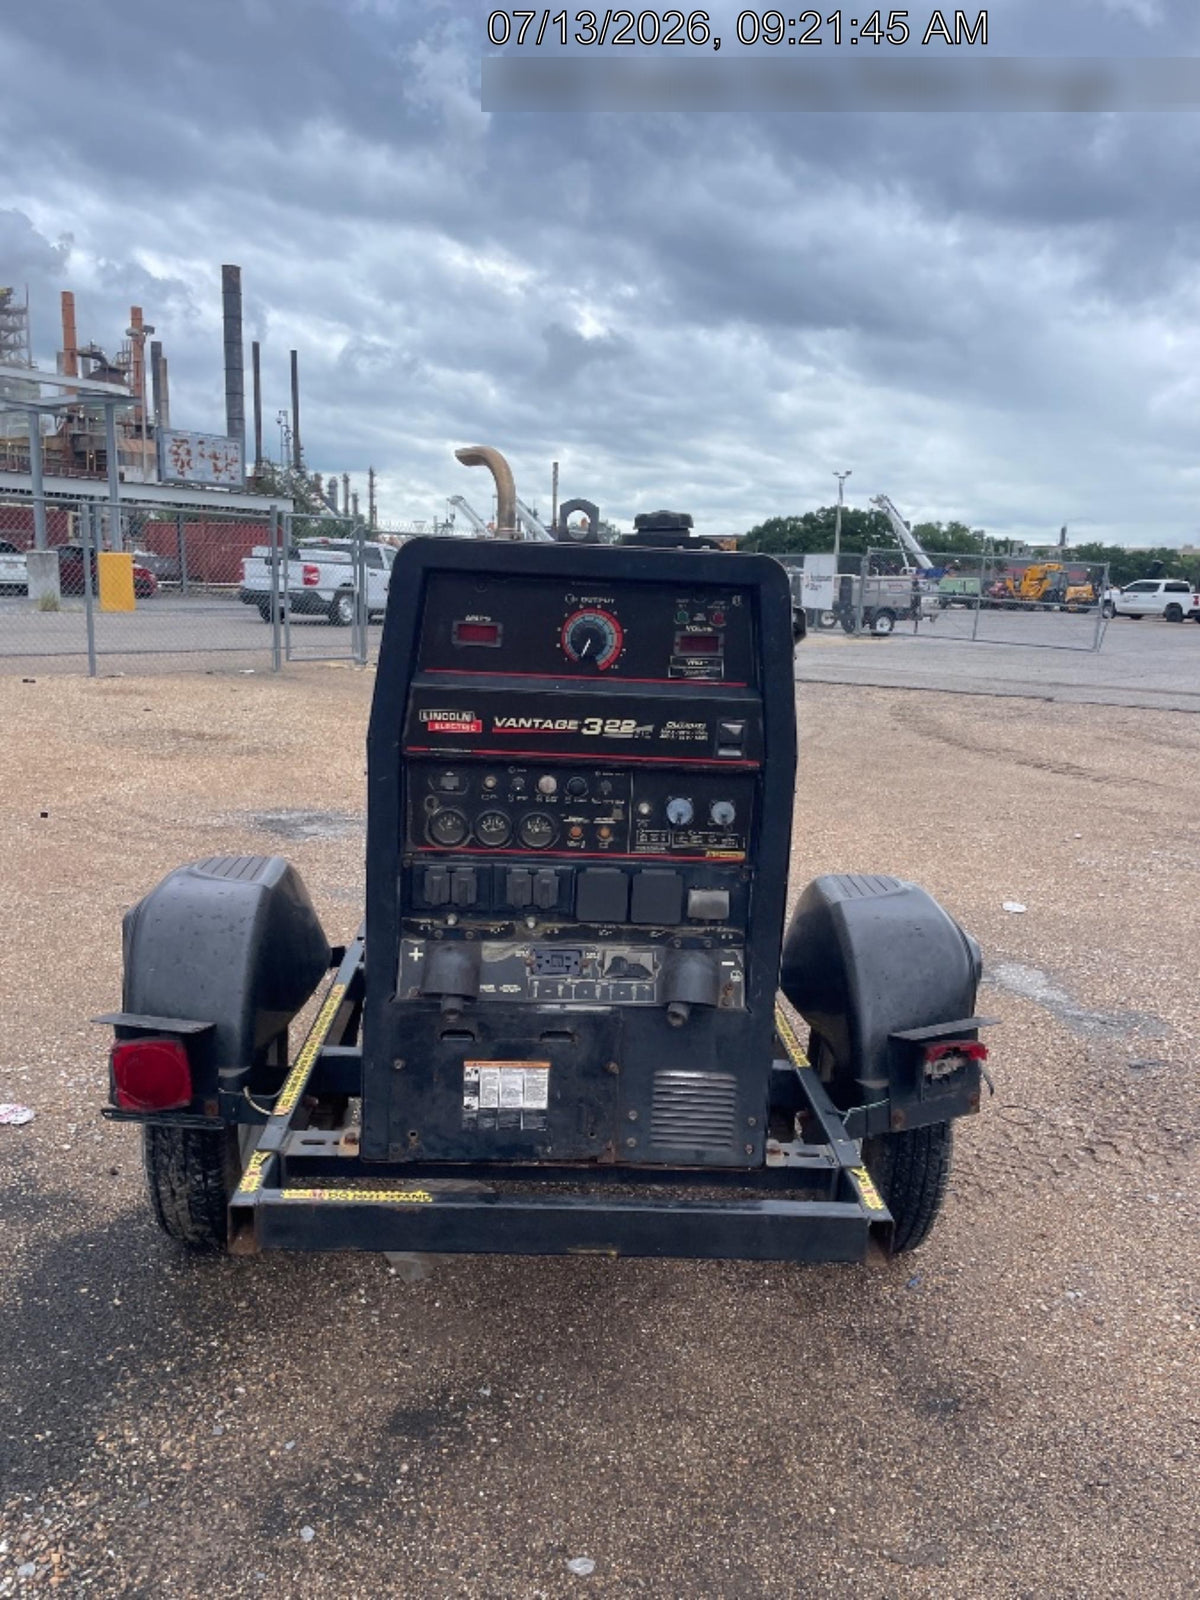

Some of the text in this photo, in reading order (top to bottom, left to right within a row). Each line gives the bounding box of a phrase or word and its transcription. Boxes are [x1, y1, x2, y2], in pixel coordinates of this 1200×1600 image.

[421, 710, 472, 721] LINCOLN
[433, 723, 477, 732] ELECTRIC
[493, 716, 580, 730] VANTAGE
[581, 717, 637, 735] 322
